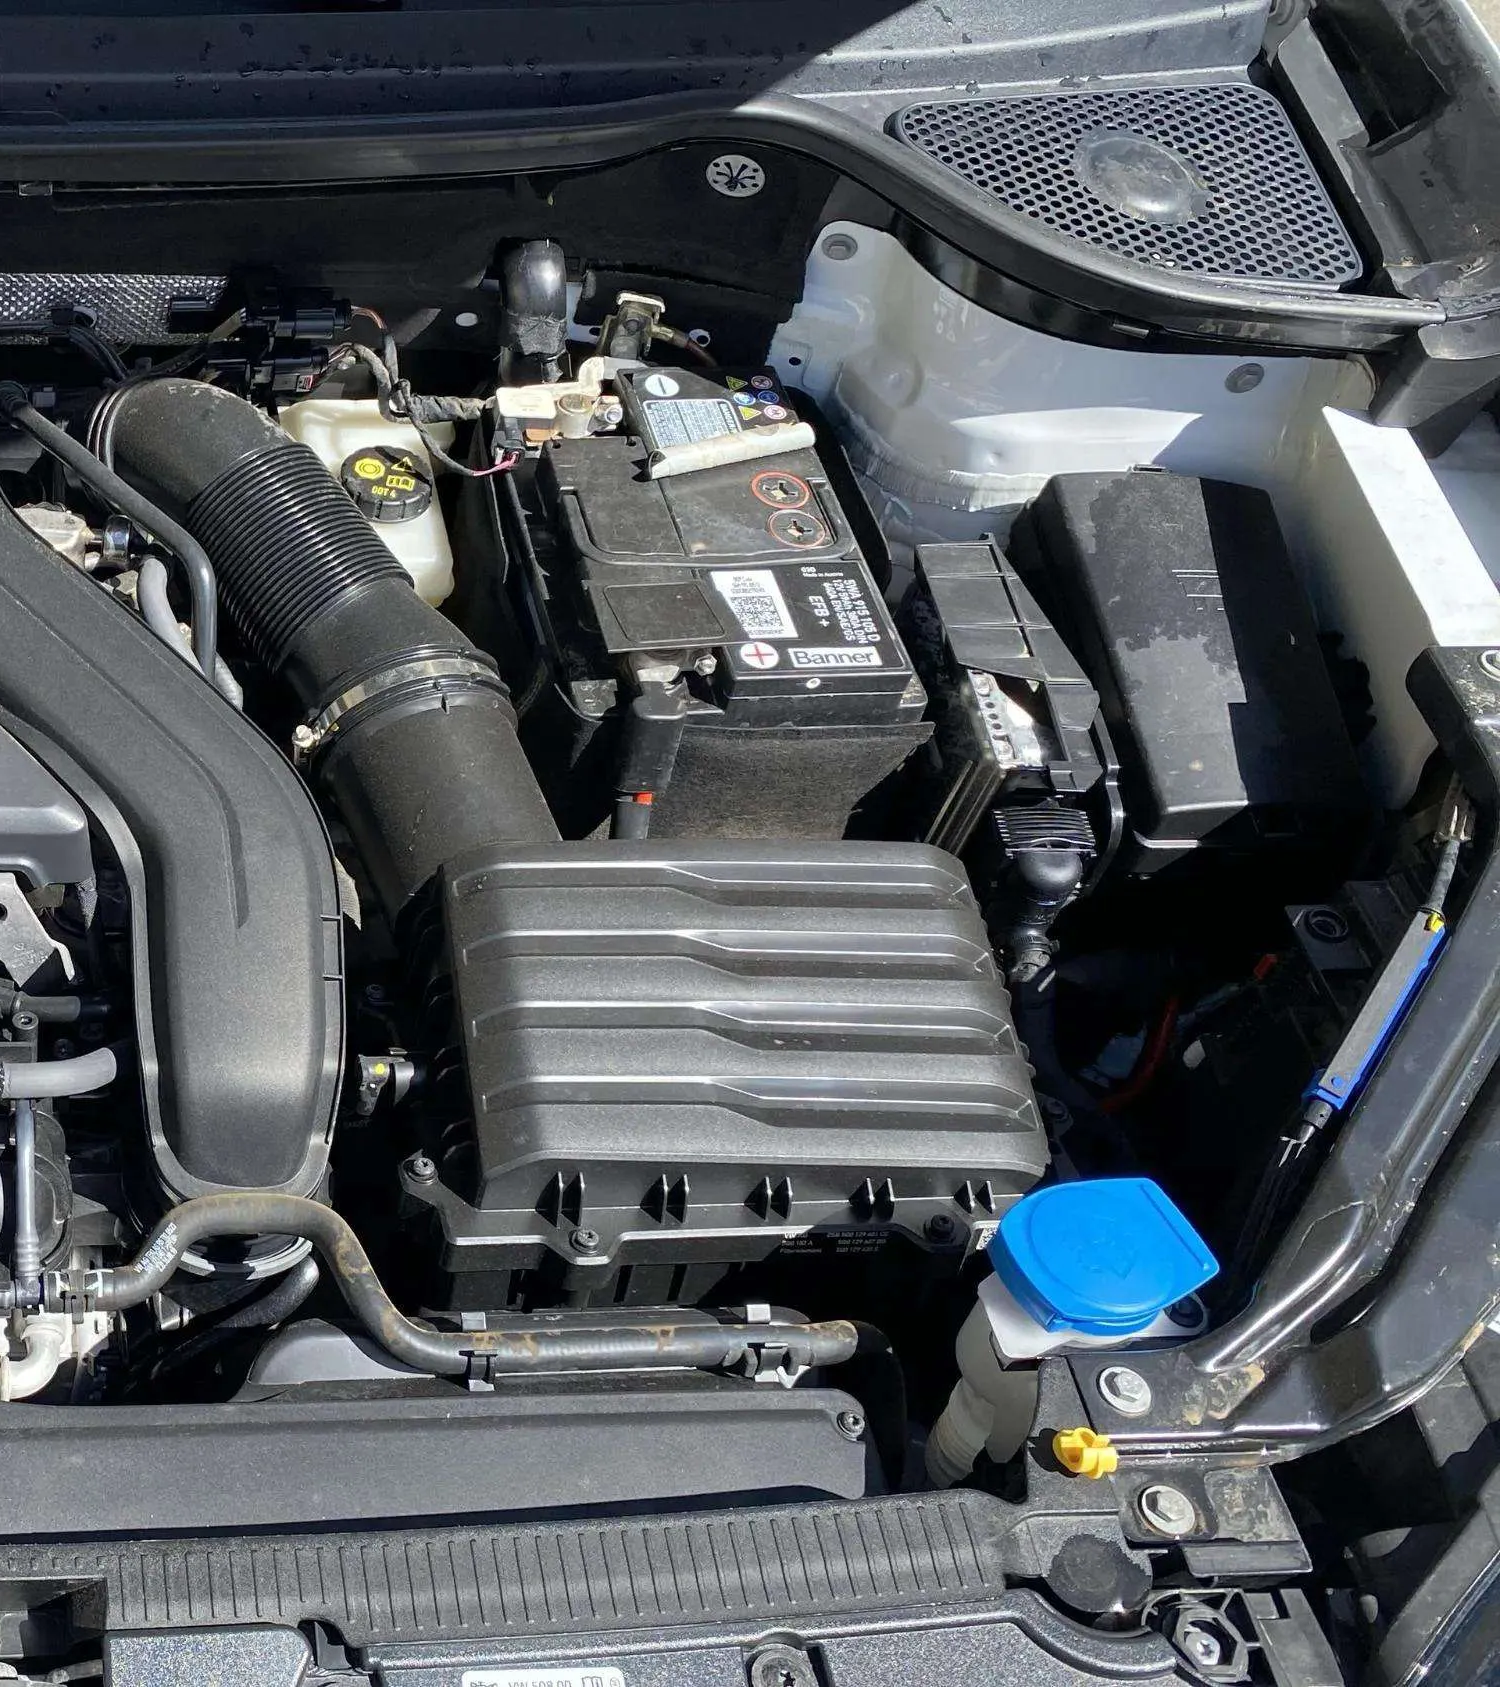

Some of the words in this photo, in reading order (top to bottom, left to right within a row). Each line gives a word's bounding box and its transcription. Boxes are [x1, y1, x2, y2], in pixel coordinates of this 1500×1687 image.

[808, 595, 830, 617] EFB
[853, 600, 870, 615] 915
[860, 617, 877, 632] 105
[793, 650, 874, 665] Banner
